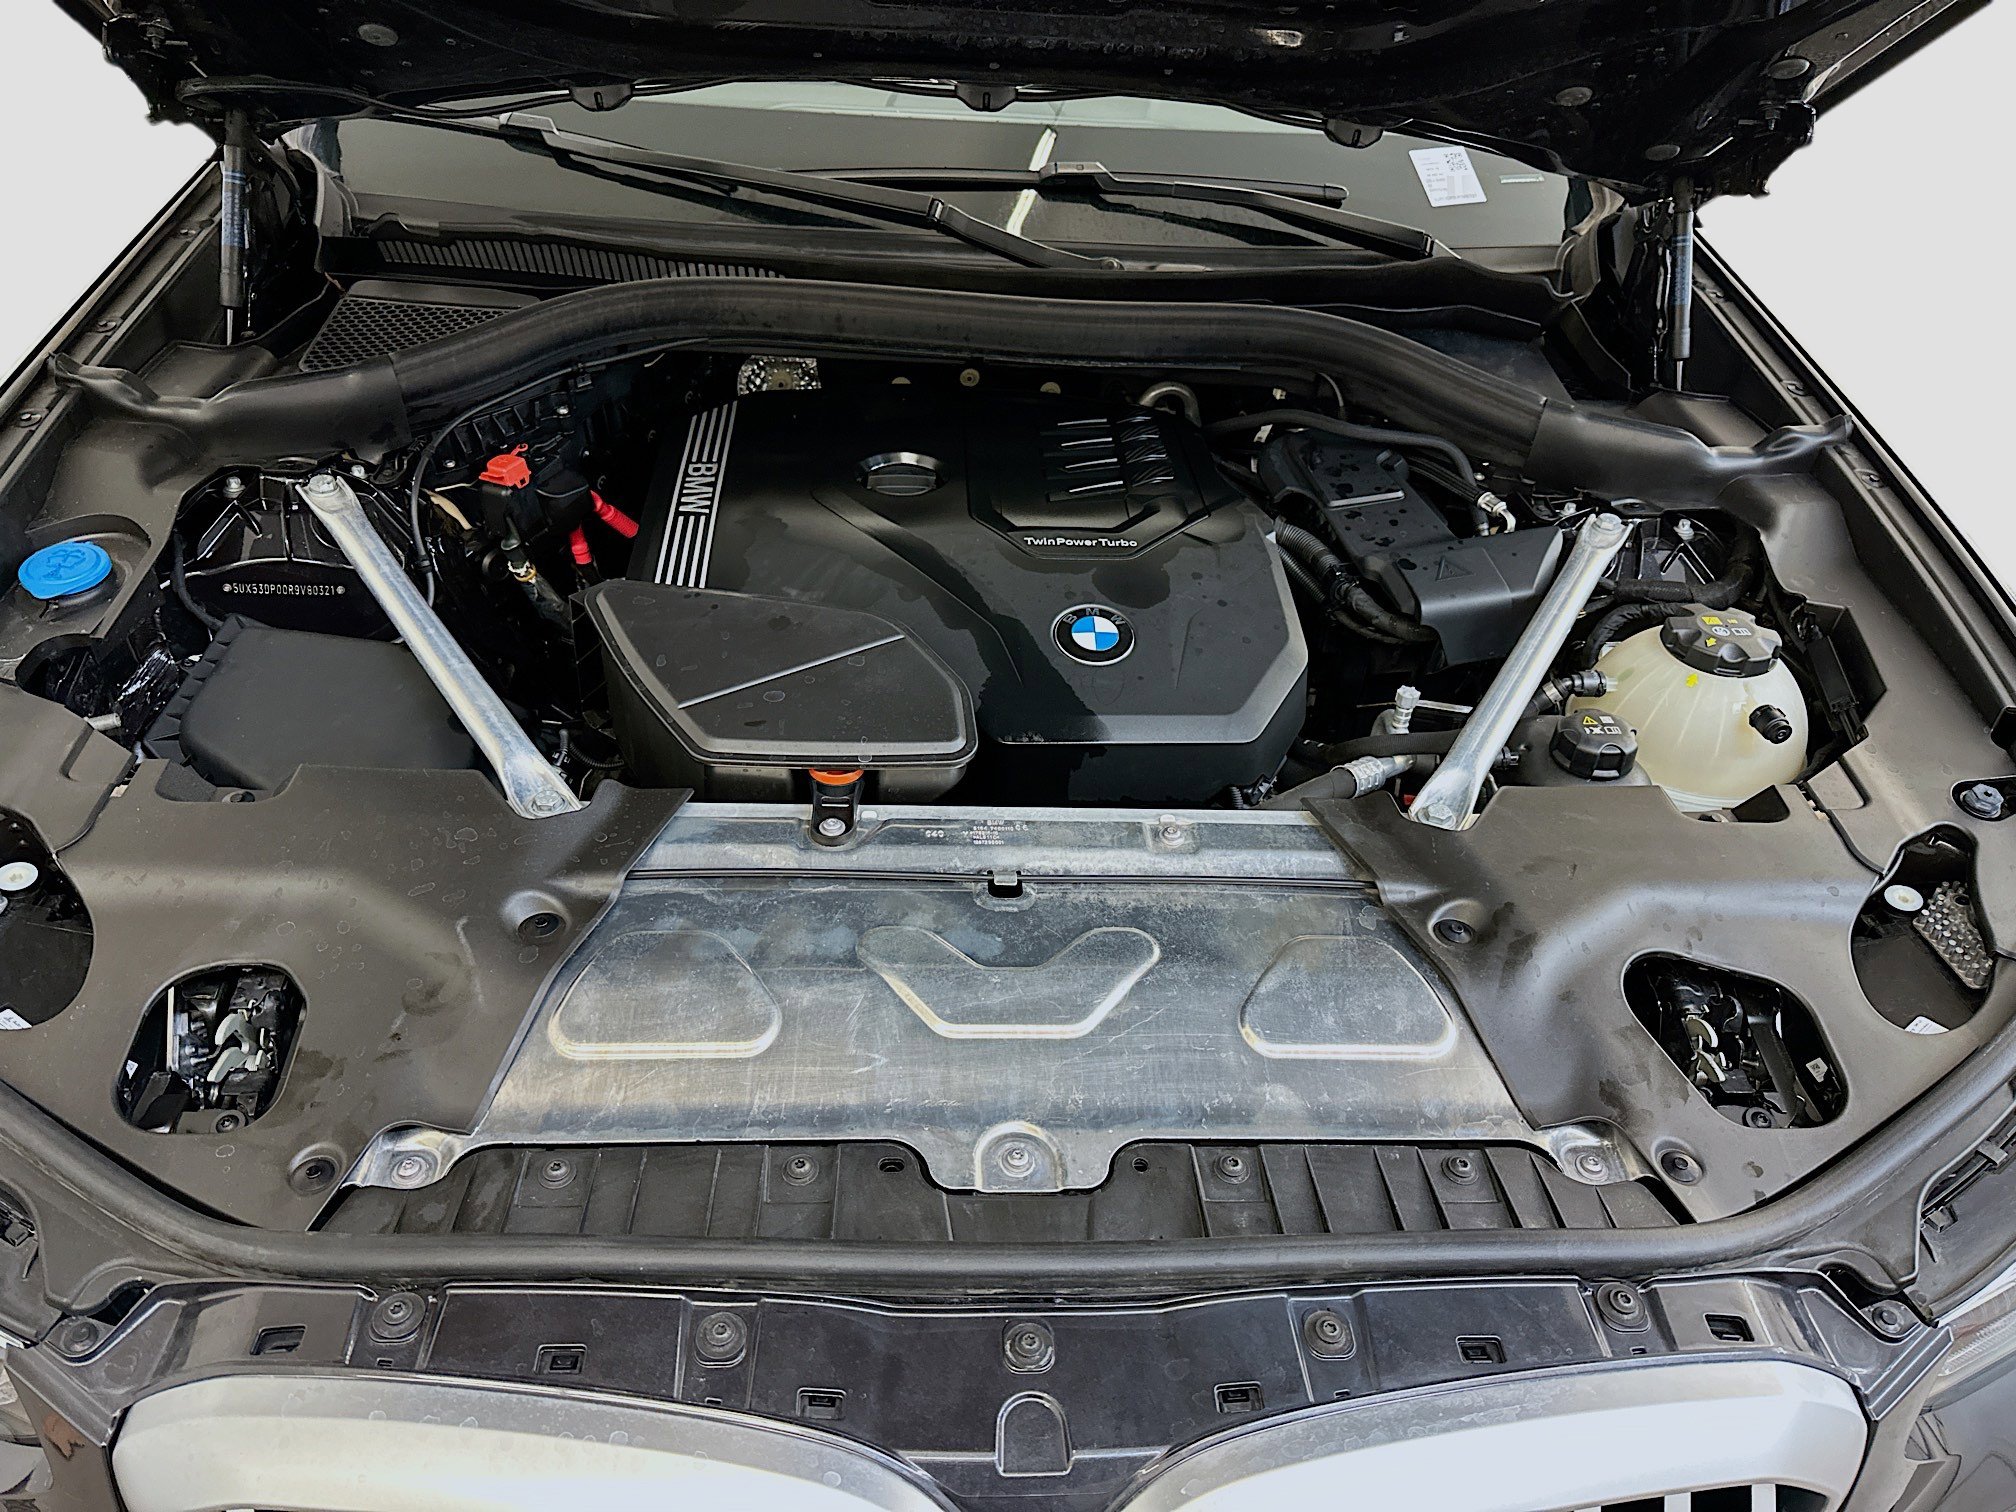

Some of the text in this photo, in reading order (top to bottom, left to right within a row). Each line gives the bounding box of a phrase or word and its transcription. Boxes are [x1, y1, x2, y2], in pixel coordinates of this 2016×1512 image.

[679, 463, 719, 514] BMW
[1023, 537, 1138, 547] TwinPower Turbo
[1063, 607, 1126, 625] BMW
